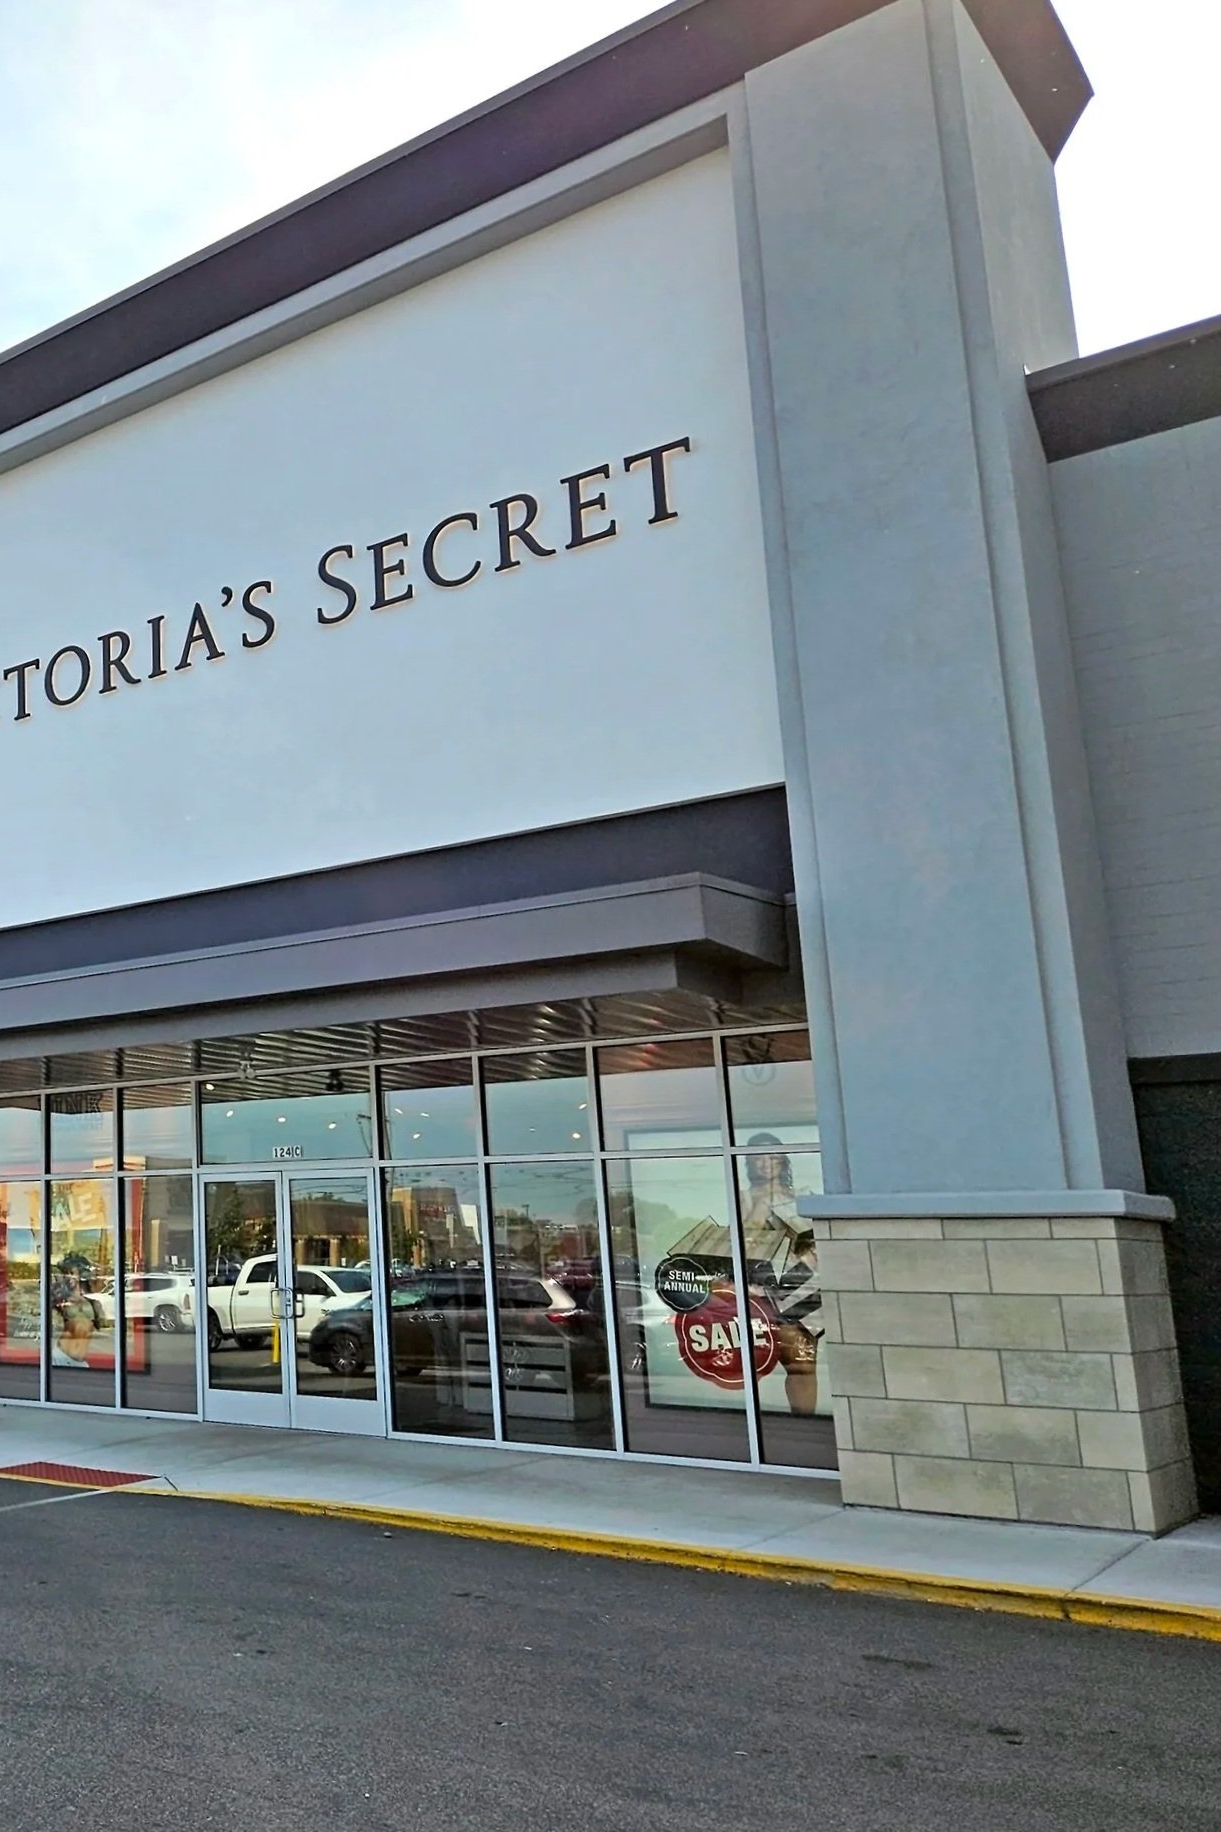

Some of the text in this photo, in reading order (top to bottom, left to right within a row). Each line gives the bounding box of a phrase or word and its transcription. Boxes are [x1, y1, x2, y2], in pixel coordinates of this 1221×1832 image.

[316, 437, 692, 627] SECRET
[663, 1280, 706, 1294] ANNUAL
[689, 1318, 768, 1353] SALE
